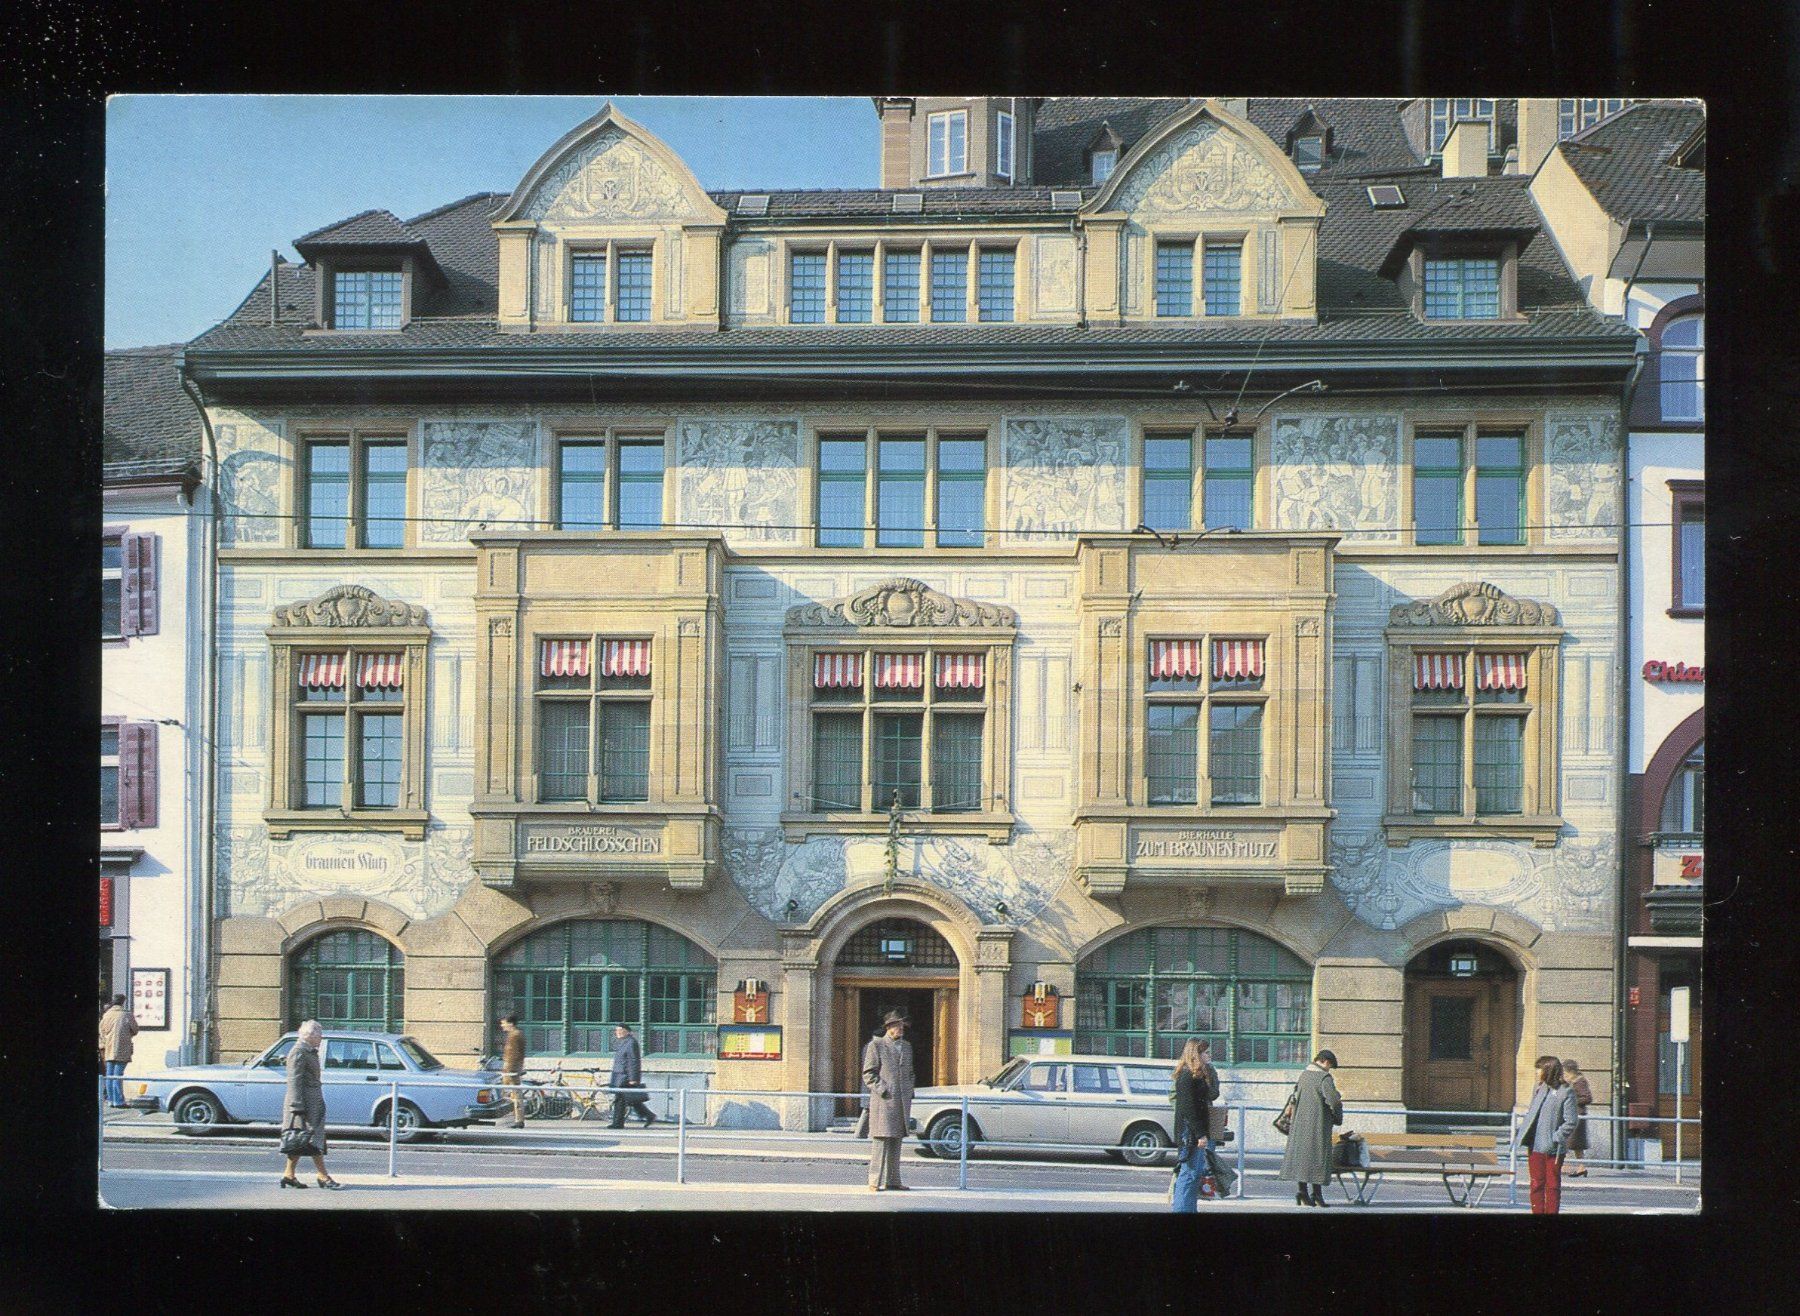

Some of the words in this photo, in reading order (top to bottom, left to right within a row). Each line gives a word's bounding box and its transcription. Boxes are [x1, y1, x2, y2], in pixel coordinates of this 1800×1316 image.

[568, 827, 617, 836] BRAUEREI
[1180, 831, 1234, 840] BIERHALLE
[1136, 841, 1165, 856] ZUM
[1170, 841, 1234, 857] BRAUNEN
[1237, 842, 1276, 857] MUTZ
